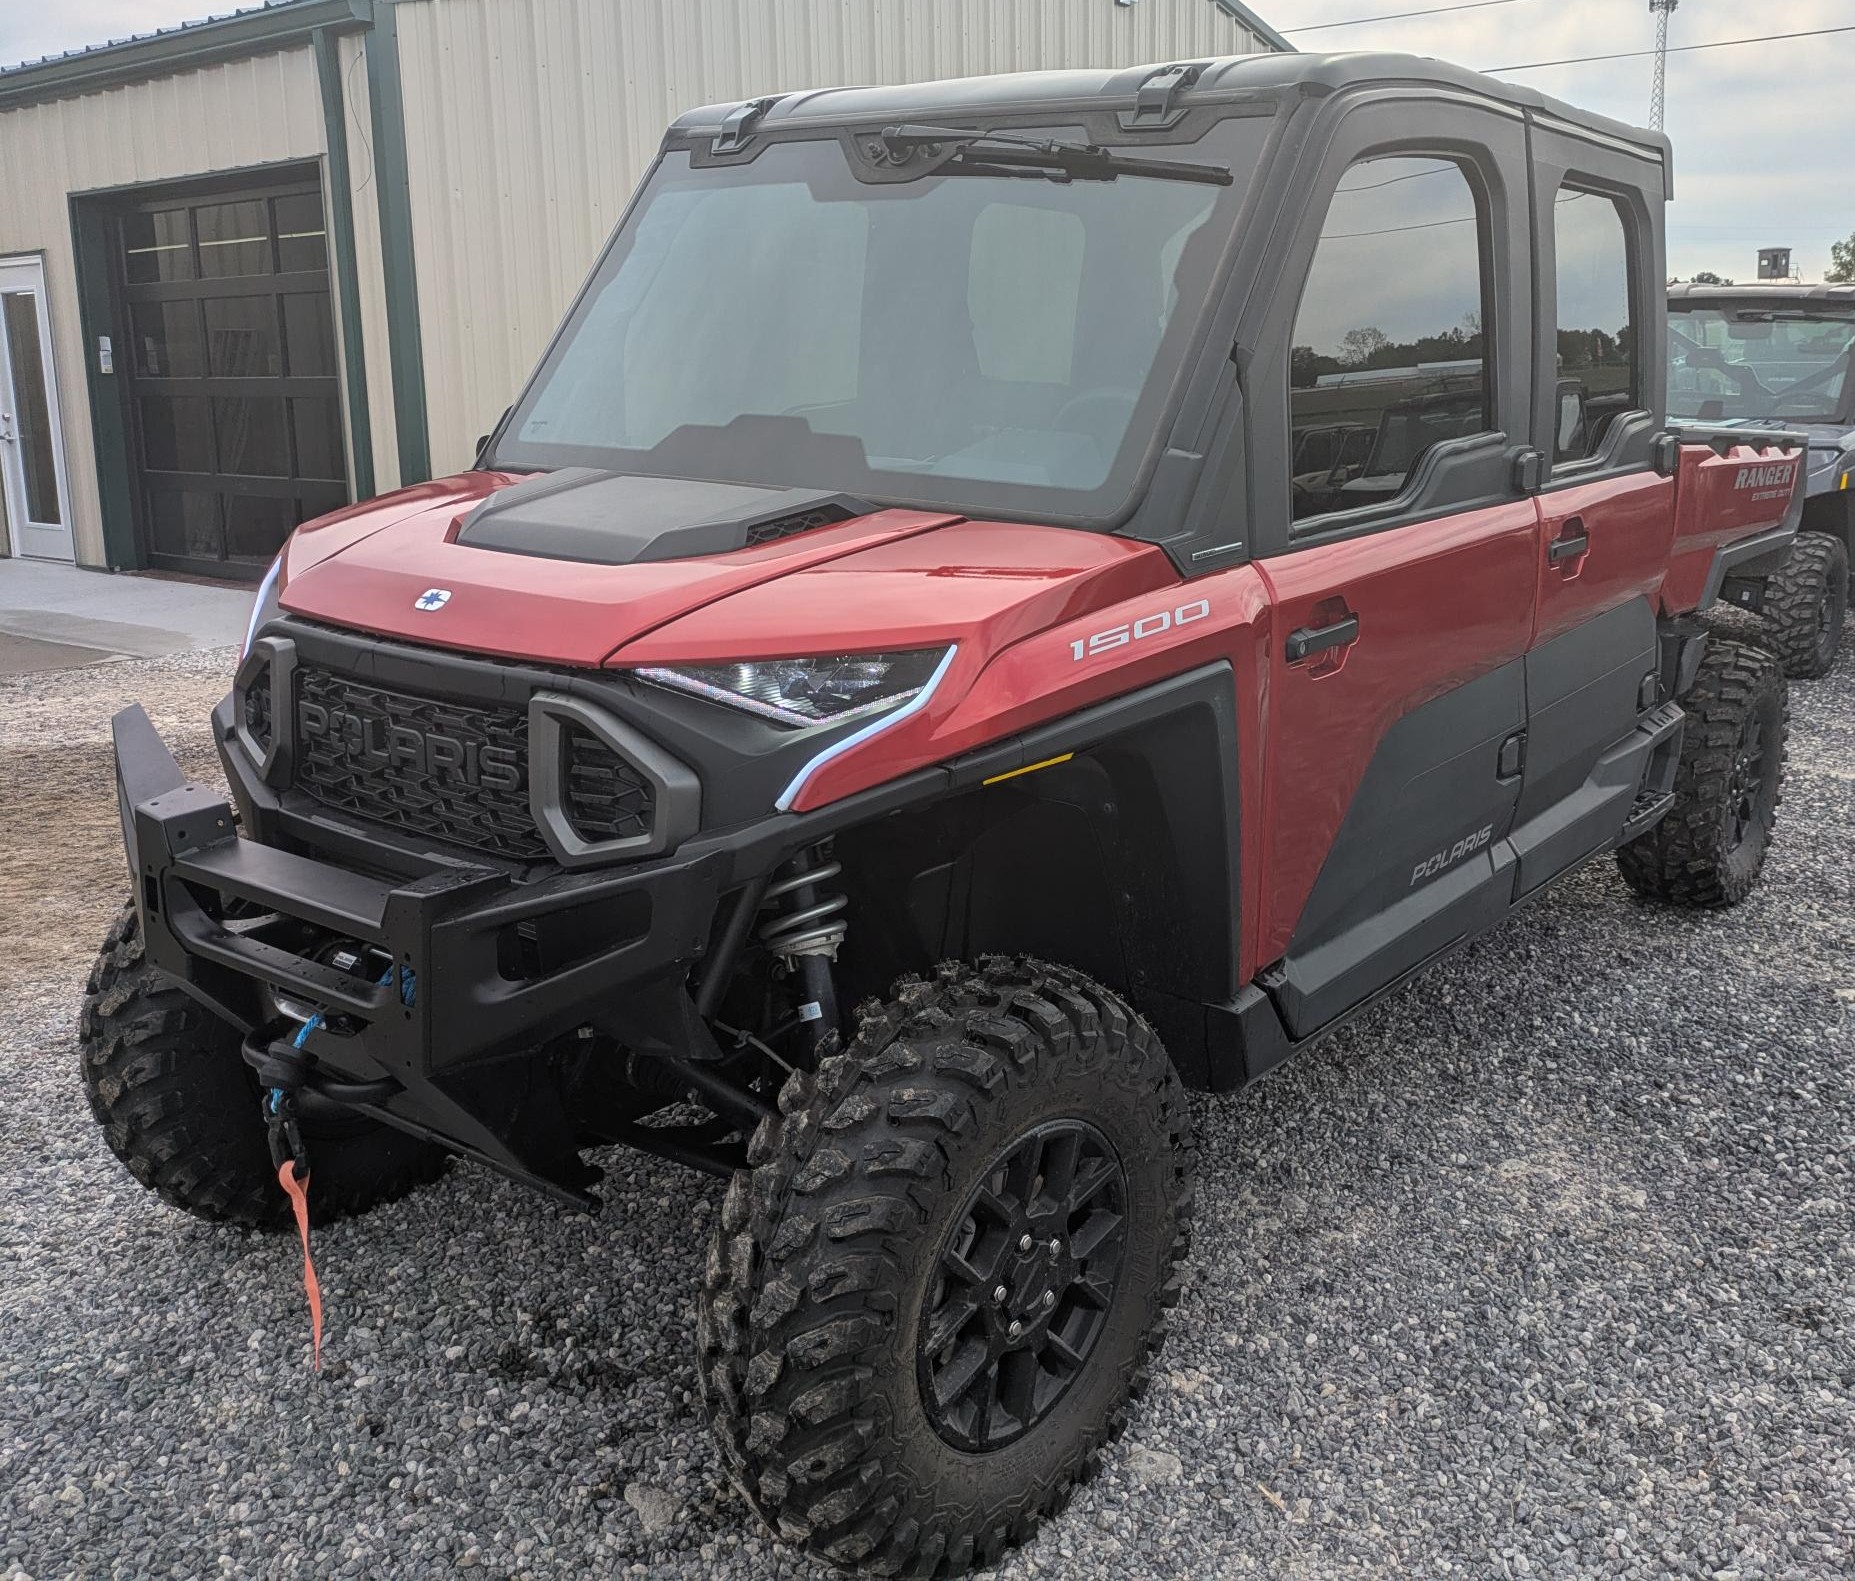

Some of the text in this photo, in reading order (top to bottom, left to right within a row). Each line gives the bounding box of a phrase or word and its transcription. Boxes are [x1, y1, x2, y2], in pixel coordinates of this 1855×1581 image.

[1735, 465, 1792, 489] RANGER
[1069, 598, 1210, 662] 1500
[299, 700, 521, 792] POLARIS
[1409, 823, 1493, 886] POLARIS
